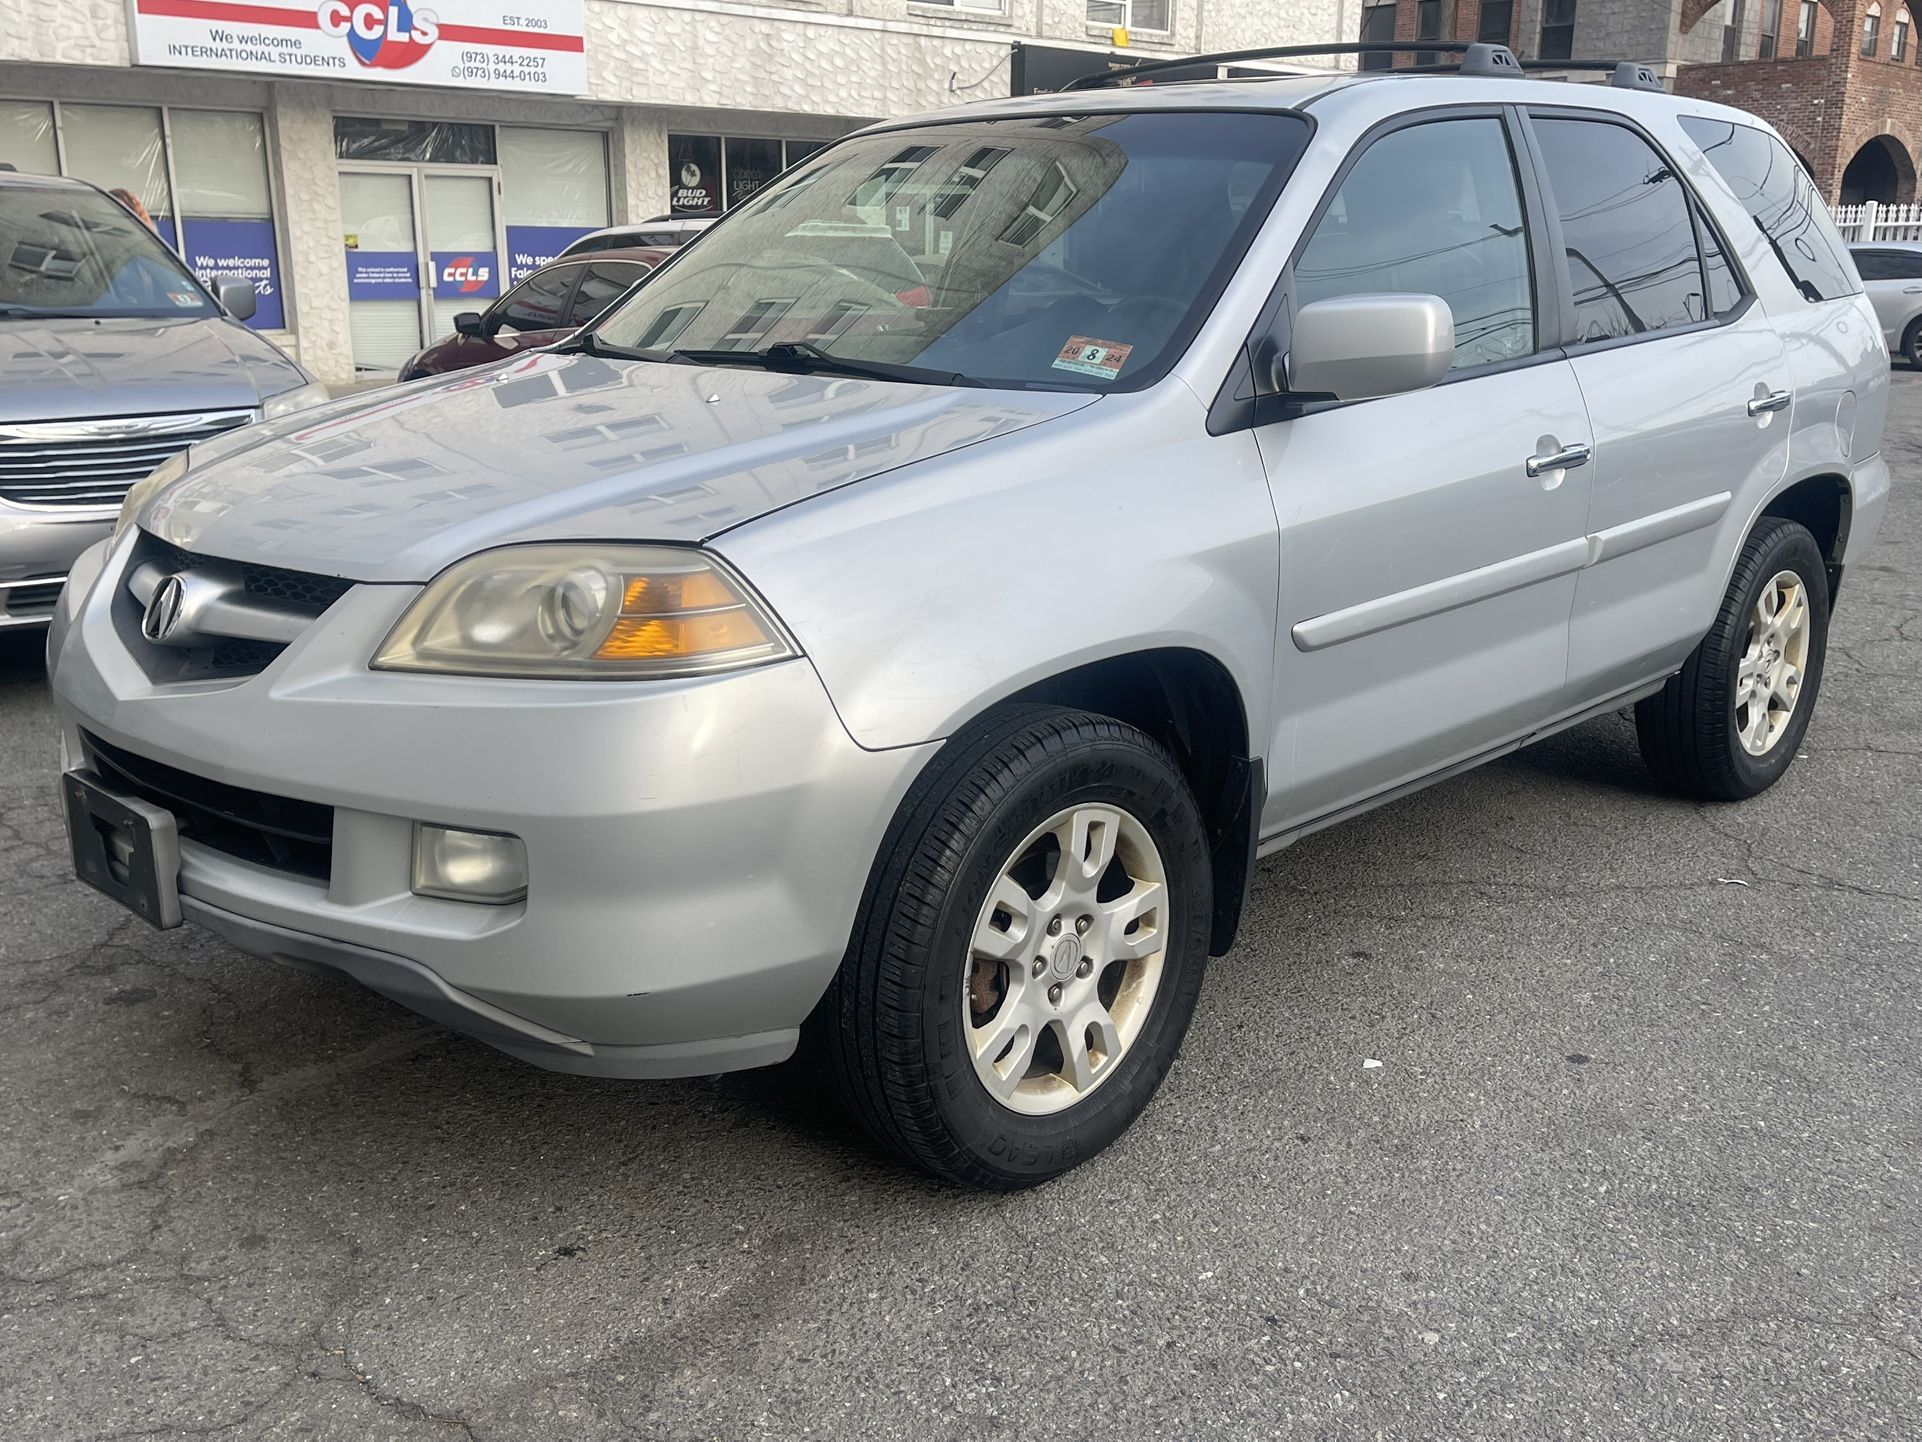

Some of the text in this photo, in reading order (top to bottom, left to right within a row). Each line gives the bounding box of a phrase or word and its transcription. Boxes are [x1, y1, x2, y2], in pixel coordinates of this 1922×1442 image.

[318, 0, 440, 45] CCLS
[502, 15, 548, 29] EST. 2003
[209, 29, 302, 50] We welcome
[168, 44, 346, 69] INTERNATIONAL STUDENTS
[461, 50, 546, 68] (973) 344-2257
[462, 66, 547, 83] (973) 944-0103
[733, 180, 760, 191] LIGHT
[677, 189, 707, 198] BUD
[671, 197, 711, 206] LIGHT
[195, 256, 270, 268] We welcome
[515, 253, 534, 265] We
[443, 267, 489, 282] CCLS
[1063, 345, 1122, 363] 20 8 24
